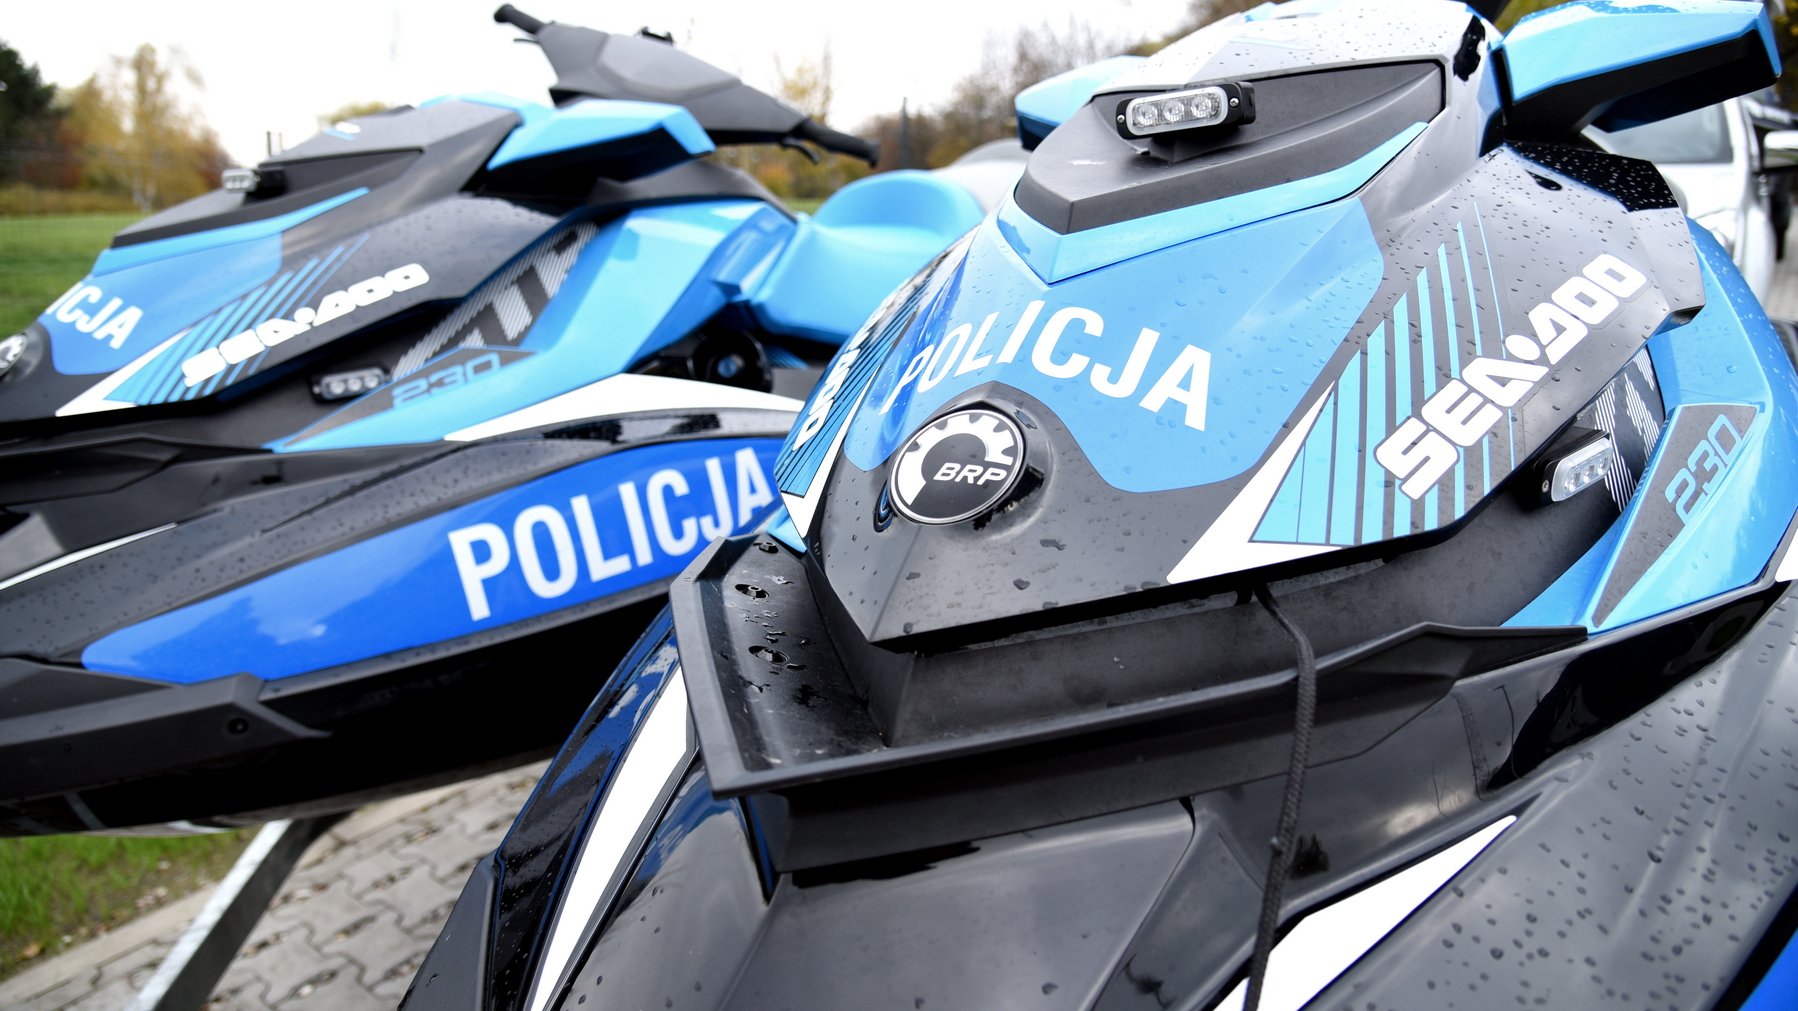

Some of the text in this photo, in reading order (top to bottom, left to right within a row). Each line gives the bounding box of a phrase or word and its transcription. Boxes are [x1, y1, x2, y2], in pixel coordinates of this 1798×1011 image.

[391, 353, 502, 409] 230
[879, 300, 1212, 432] POLICJA
[933, 462, 1008, 486] BRP
[1665, 414, 1744, 526] 230
[448, 447, 776, 621] POLICJA
